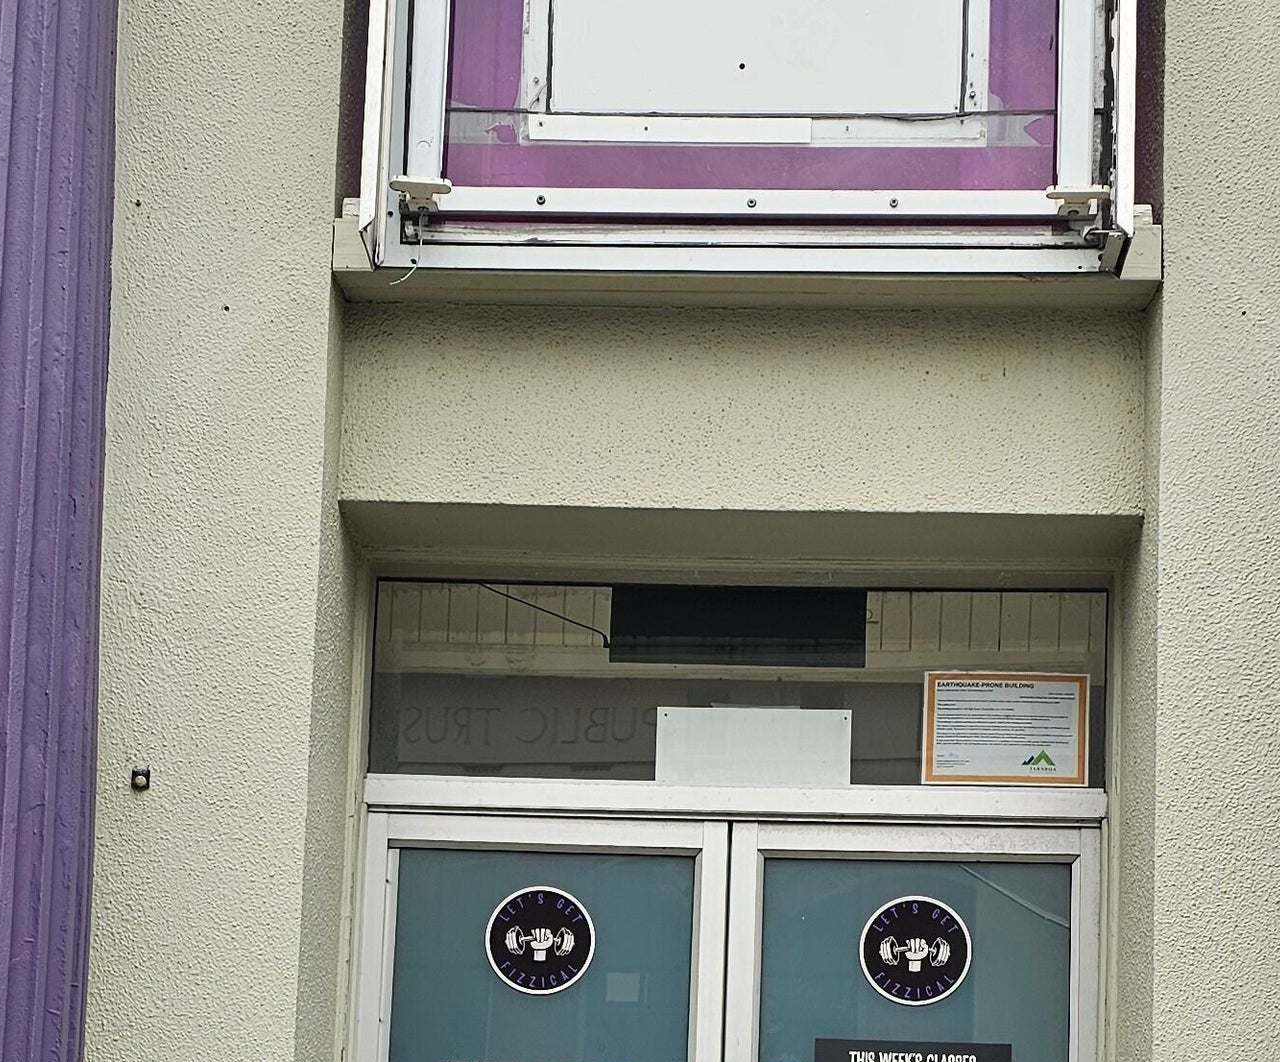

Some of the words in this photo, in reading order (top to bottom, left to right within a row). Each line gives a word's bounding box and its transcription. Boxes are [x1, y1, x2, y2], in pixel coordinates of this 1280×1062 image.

[500, 893, 544, 922] LET'S
[556, 898, 583, 923] GET
[873, 903, 918, 932] LET'S
[932, 908, 959, 933] GET
[500, 961, 578, 988] FIZZICAL
[874, 972, 954, 999] FIZZICAL
